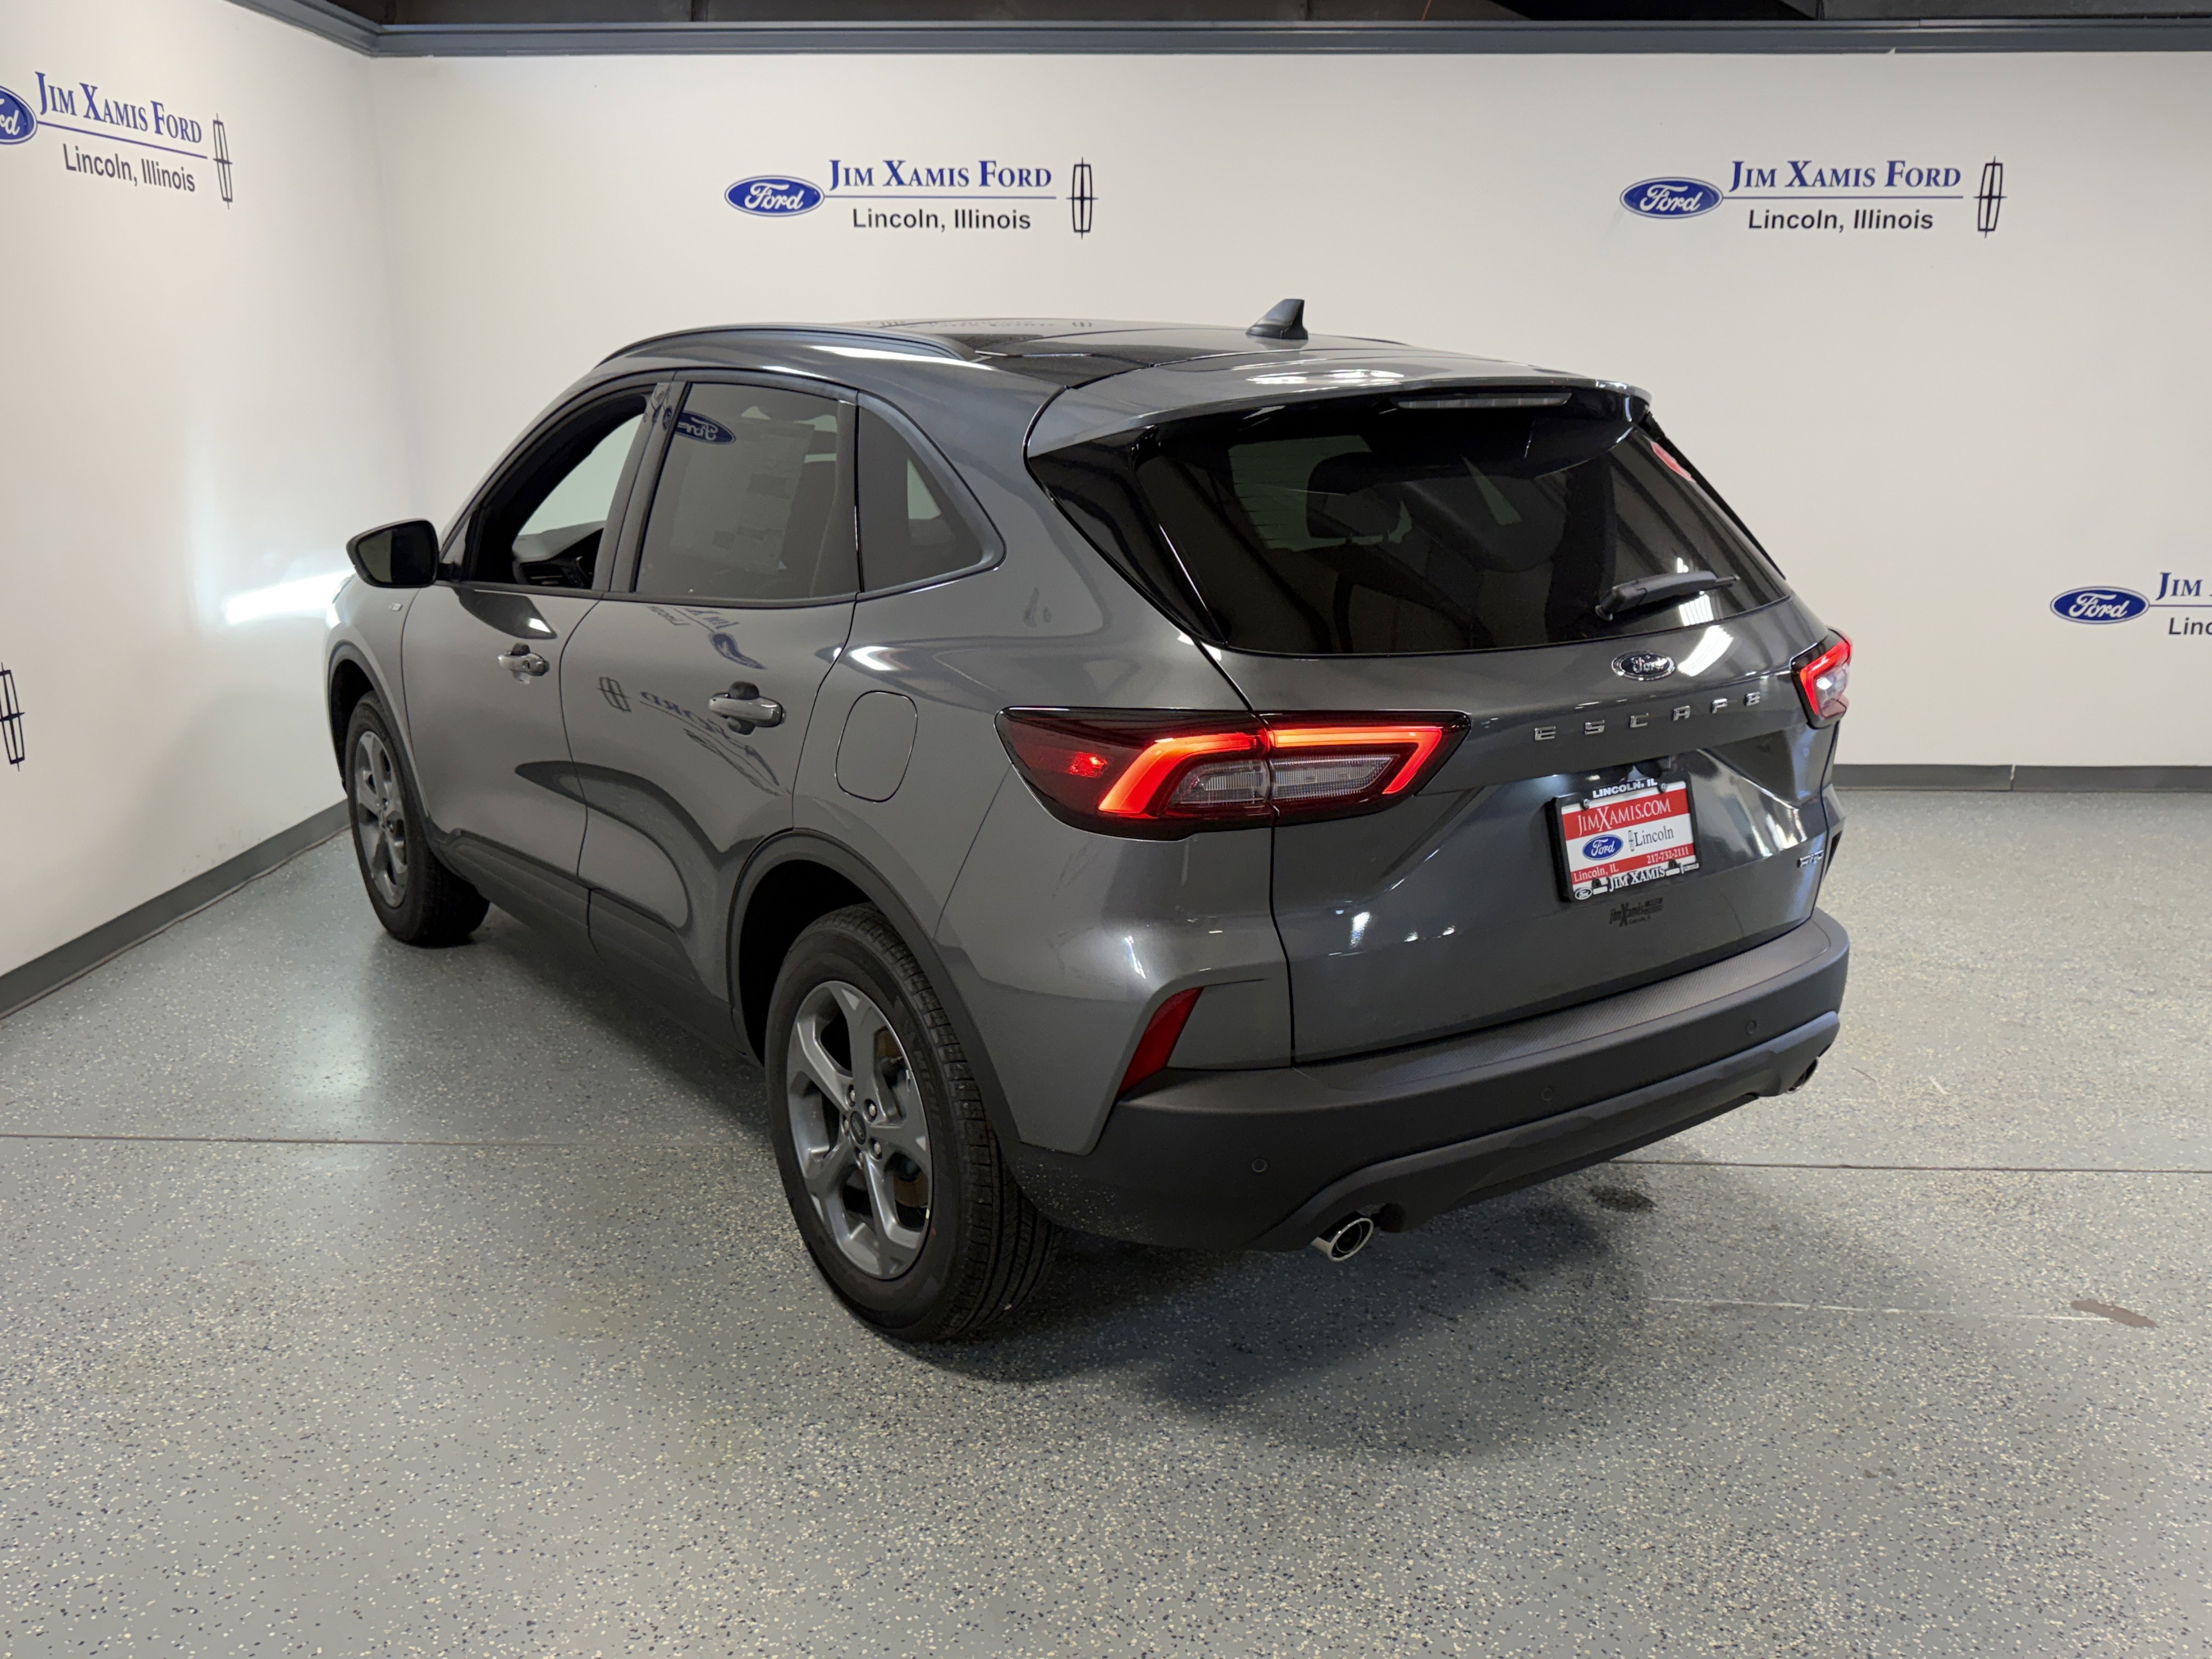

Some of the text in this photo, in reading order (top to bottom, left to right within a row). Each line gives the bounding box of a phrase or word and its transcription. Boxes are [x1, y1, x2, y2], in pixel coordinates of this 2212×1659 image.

[35, 71, 202, 143] JIM XAMIS FORD
[63, 143, 196, 193] Lincoln, Illinois
[829, 160, 1052, 191] JIM XAMIS FORD
[1729, 160, 1961, 193] JIM XAMIS FORD
[744, 182, 804, 211] Ford
[1640, 184, 1703, 212] Ford
[853, 208, 1031, 233] Lincoln, Illinois
[1748, 209, 1933, 233] Lincoln, Illinois
[2155, 572, 2203, 601] JIM
[2068, 592, 2130, 618] Ford
[1632, 656, 1668, 674] Ford
[1534, 691, 1761, 741] ESCAPE
[1593, 778, 1658, 798] LINCOLN, IL
[1577, 798, 1672, 837] JIMXAMIS.COM
[1591, 838, 1616, 857] Ford
[1634, 826, 1674, 847] Lincoln
[1646, 846, 1689, 864] 217-732-2111
[1573, 864, 1619, 882] Lincoln, IL
[1607, 876, 1629, 893] JIM
[1630, 866, 1666, 885] XAMIS
